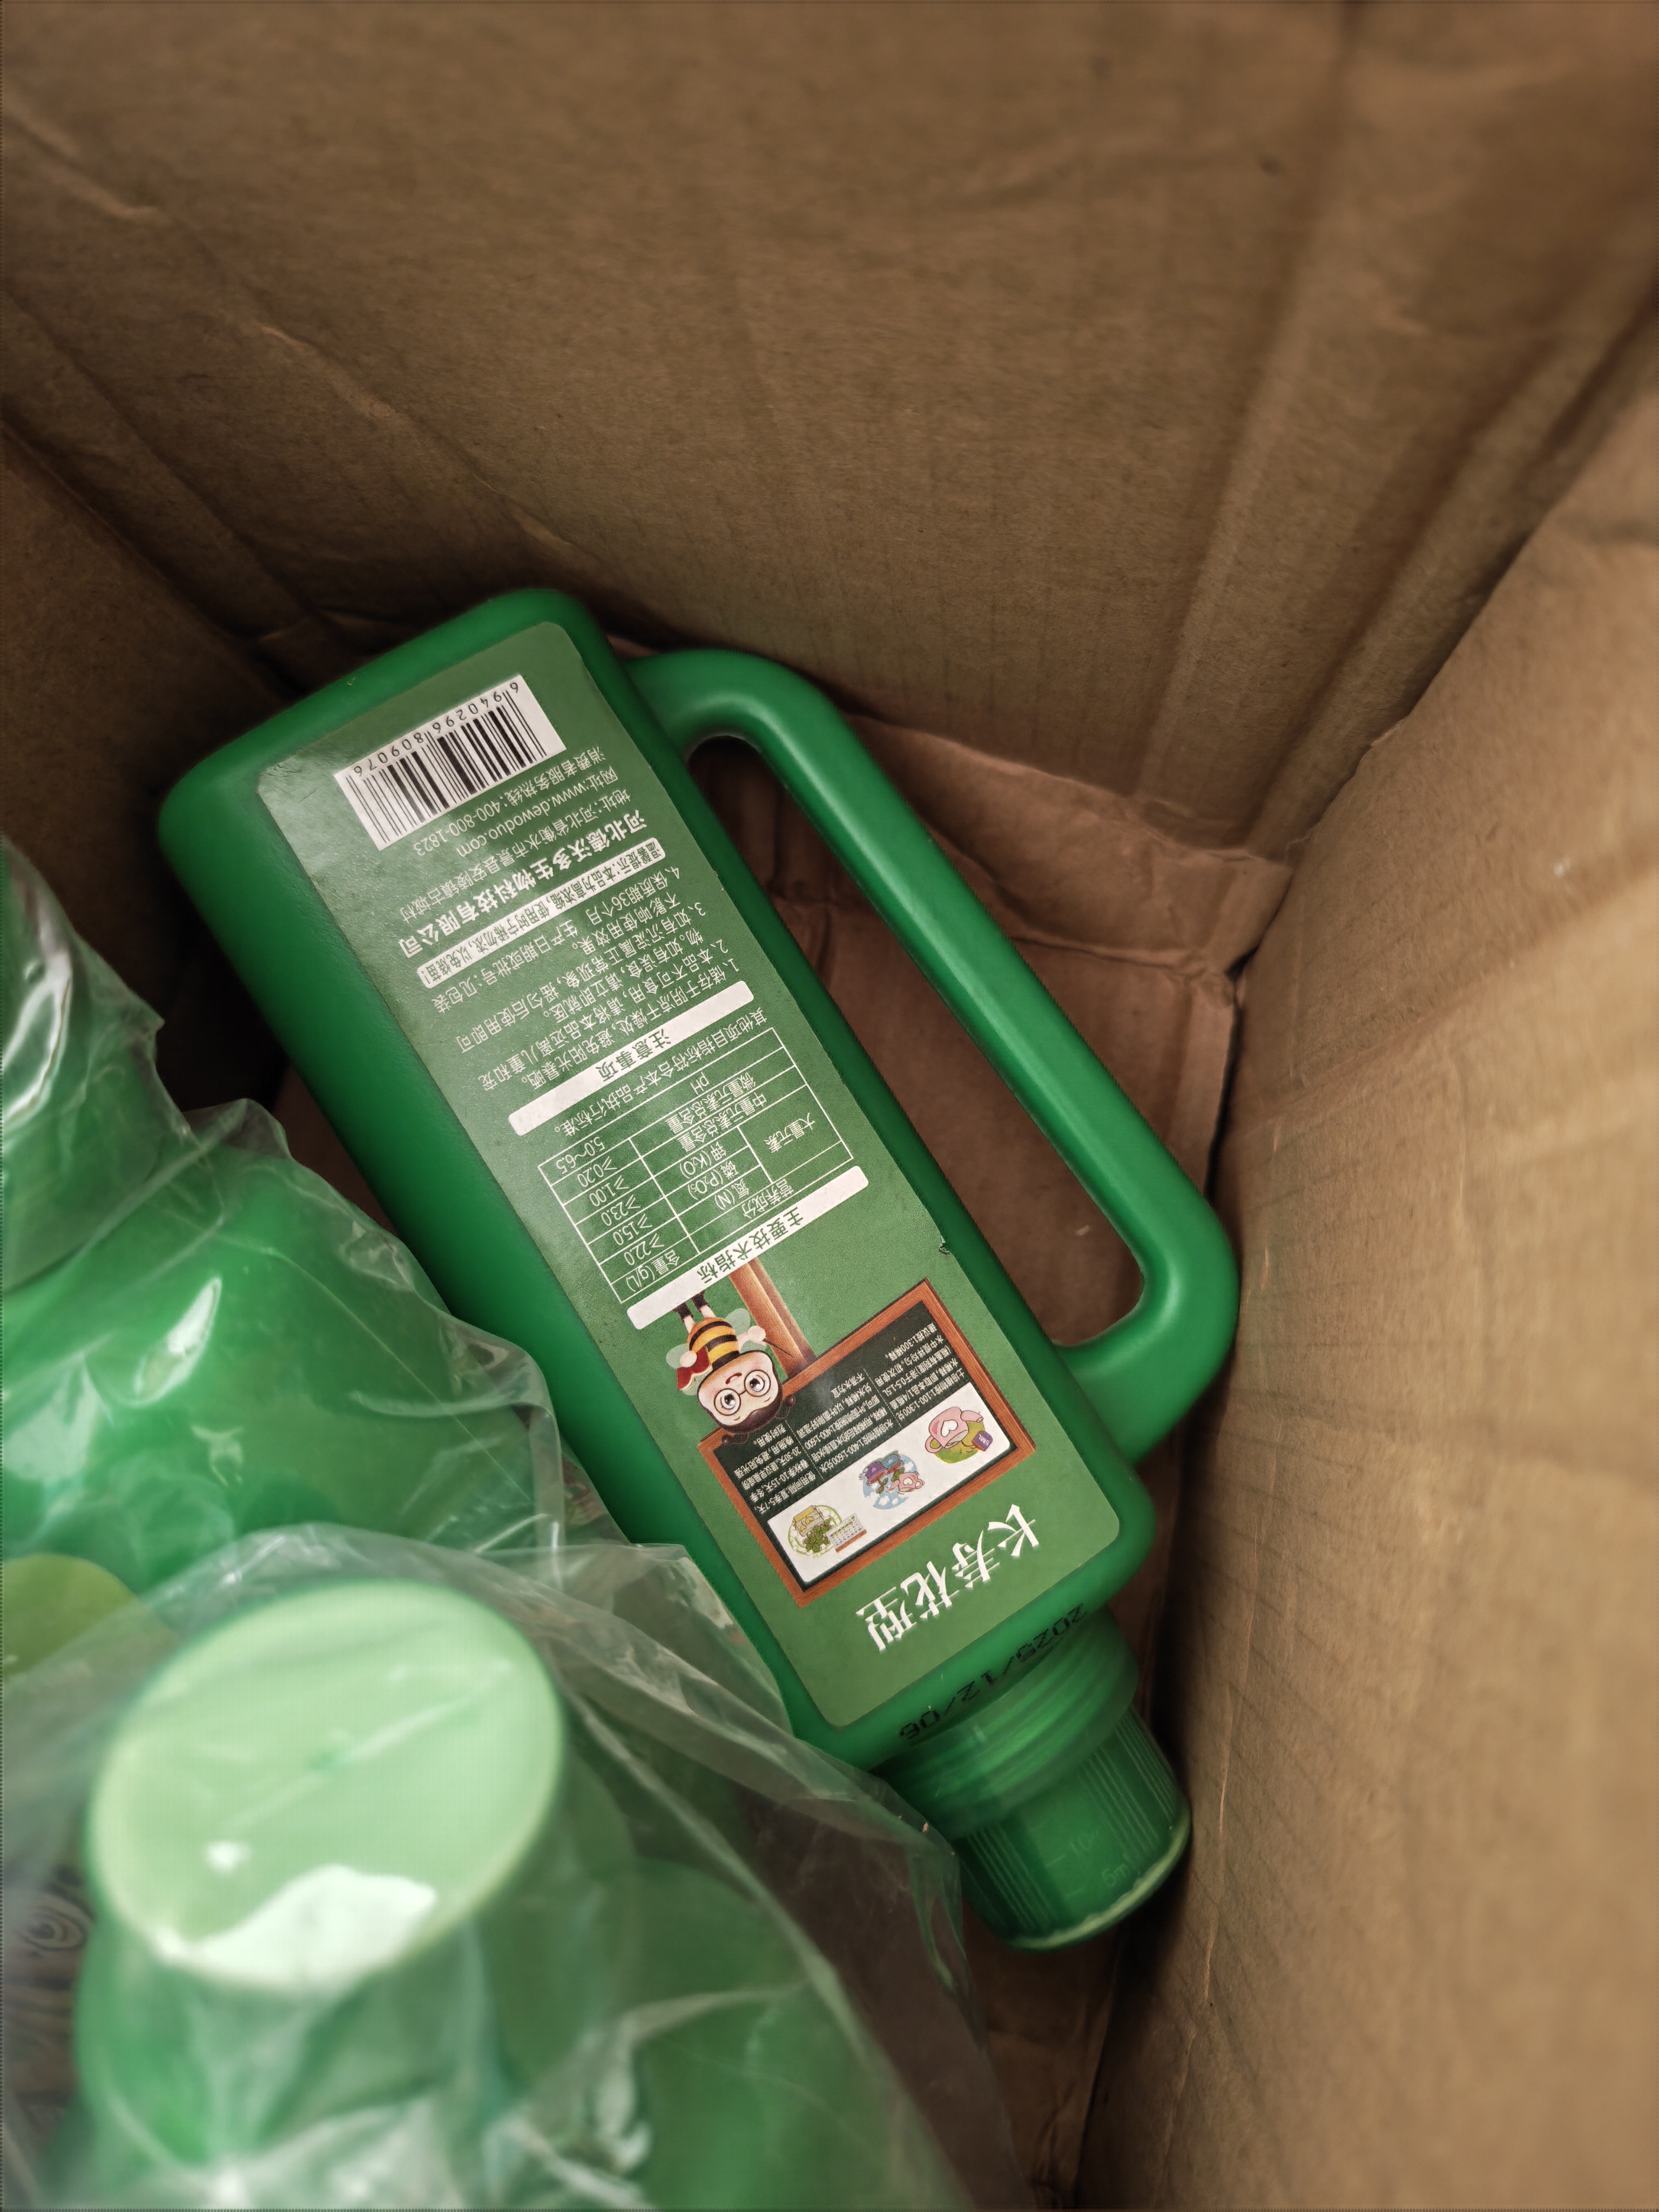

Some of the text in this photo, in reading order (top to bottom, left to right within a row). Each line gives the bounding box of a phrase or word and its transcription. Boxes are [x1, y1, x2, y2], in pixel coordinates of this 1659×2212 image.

[396, 808, 648, 959] 河北德沃多生物科技有限公司
[570, 889, 680, 959] 不影响使用效果。
[551, 1006, 768, 1142] 其他项目指标符合本产品执行标准。
[595, 1028, 671, 1082] 注意事项
[664, 1070, 757, 1134] 微量元素总含量
[688, 1071, 710, 1095] pH
[676, 1089, 767, 1153] 中量元素总含量
[763, 1112, 817, 1154] 大量元素
[575, 1155, 616, 1188] ≥0.20
[586, 1174, 628, 1208] ≥1.00
[599, 1193, 640, 1228] ≥23.0
[711, 1178, 751, 1211] 氮(N)
[739, 1177, 794, 1220] 营养成分
[611, 1212, 652, 1247] ≥15.0
[622, 1232, 664, 1267] ≥22.0
[694, 1206, 805, 1285] 主要技术指标
[623, 1247, 682, 1293] 含量(g/L)
[830, 1370, 865, 1398] 不滴水为宜
[752, 1423, 786, 1449] 烈时使用。
[854, 1499, 1047, 1654] 长寿花型
[899, 1603, 1087, 1739] 2025/12/06
